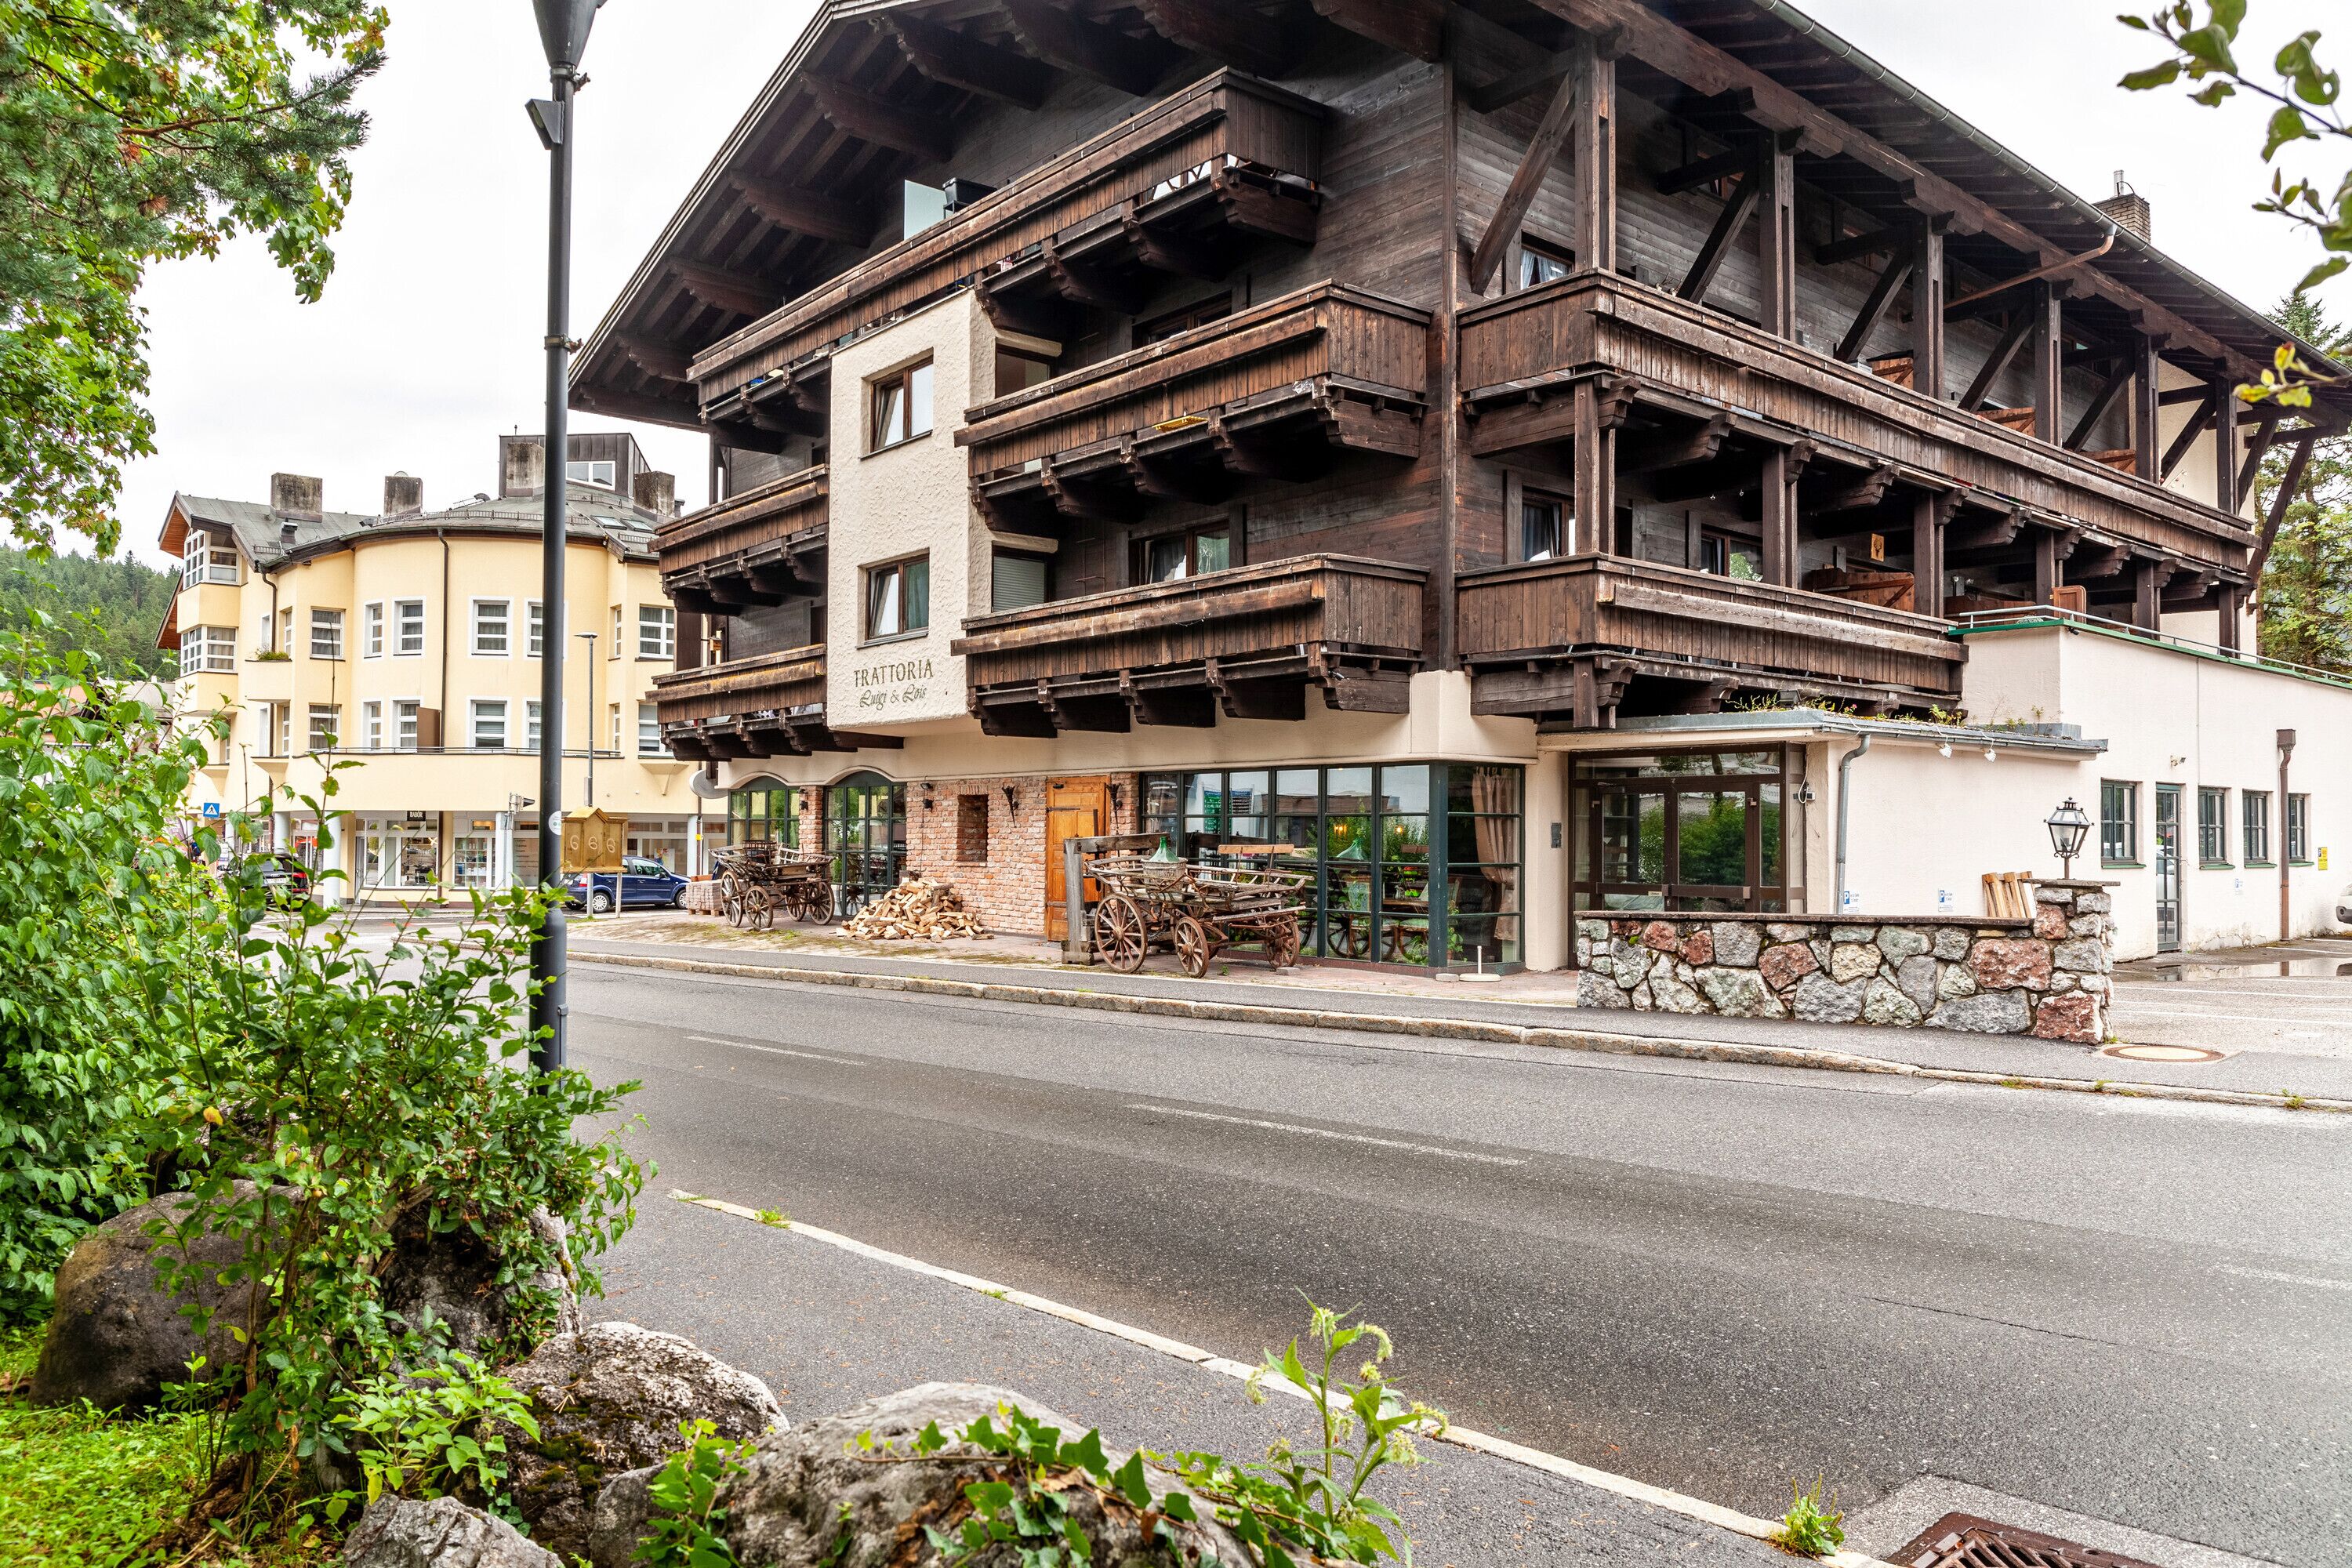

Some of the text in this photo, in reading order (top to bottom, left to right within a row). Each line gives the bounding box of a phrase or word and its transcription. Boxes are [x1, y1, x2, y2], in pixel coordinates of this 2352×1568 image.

[854, 659, 934, 688] TRATTORIA
[859, 684, 927, 710] Luigi & Lois
[1844, 891, 1849, 904] P
[1940, 891, 1944, 902] P
